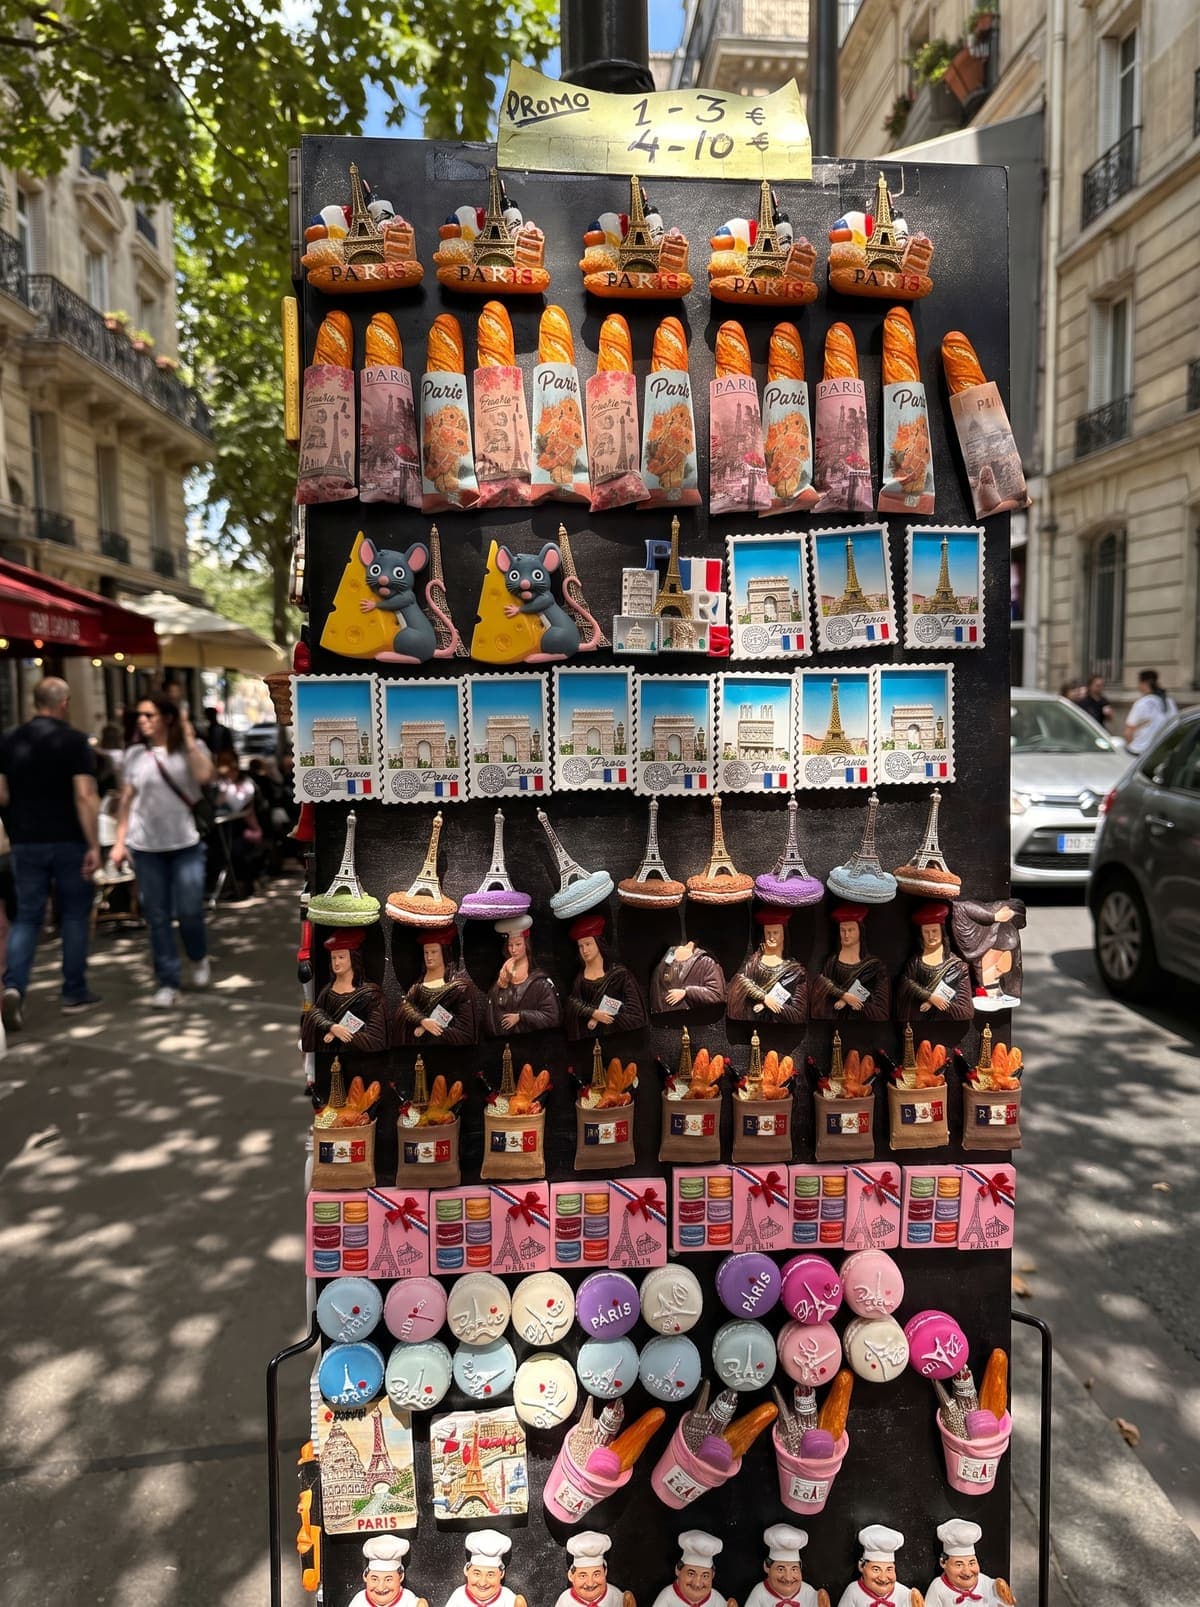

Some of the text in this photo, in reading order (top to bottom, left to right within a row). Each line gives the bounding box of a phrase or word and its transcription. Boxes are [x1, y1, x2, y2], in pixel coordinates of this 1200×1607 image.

[505, 91, 590, 121] PROMO
[632, 98, 652, 127] 1
[696, 95, 727, 123] 3
[745, 107, 766, 126] €
[746, 132, 769, 151] €
[330, 263, 407, 281] PARIS
[458, 264, 534, 285] PARIS
[605, 271, 680, 290] PARIS
[853, 270, 921, 292] PARIS
[733, 277, 805, 298] PARIS
[365, 368, 410, 386] PARIS
[820, 380, 864, 397] PARIS
[852, 614, 887, 628] Paris
[941, 615, 977, 628] Paris
[742, 1271, 771, 1313] PARIS
[590, 1301, 633, 1330] PARIS
[357, 1516, 398, 1531] PARIS
